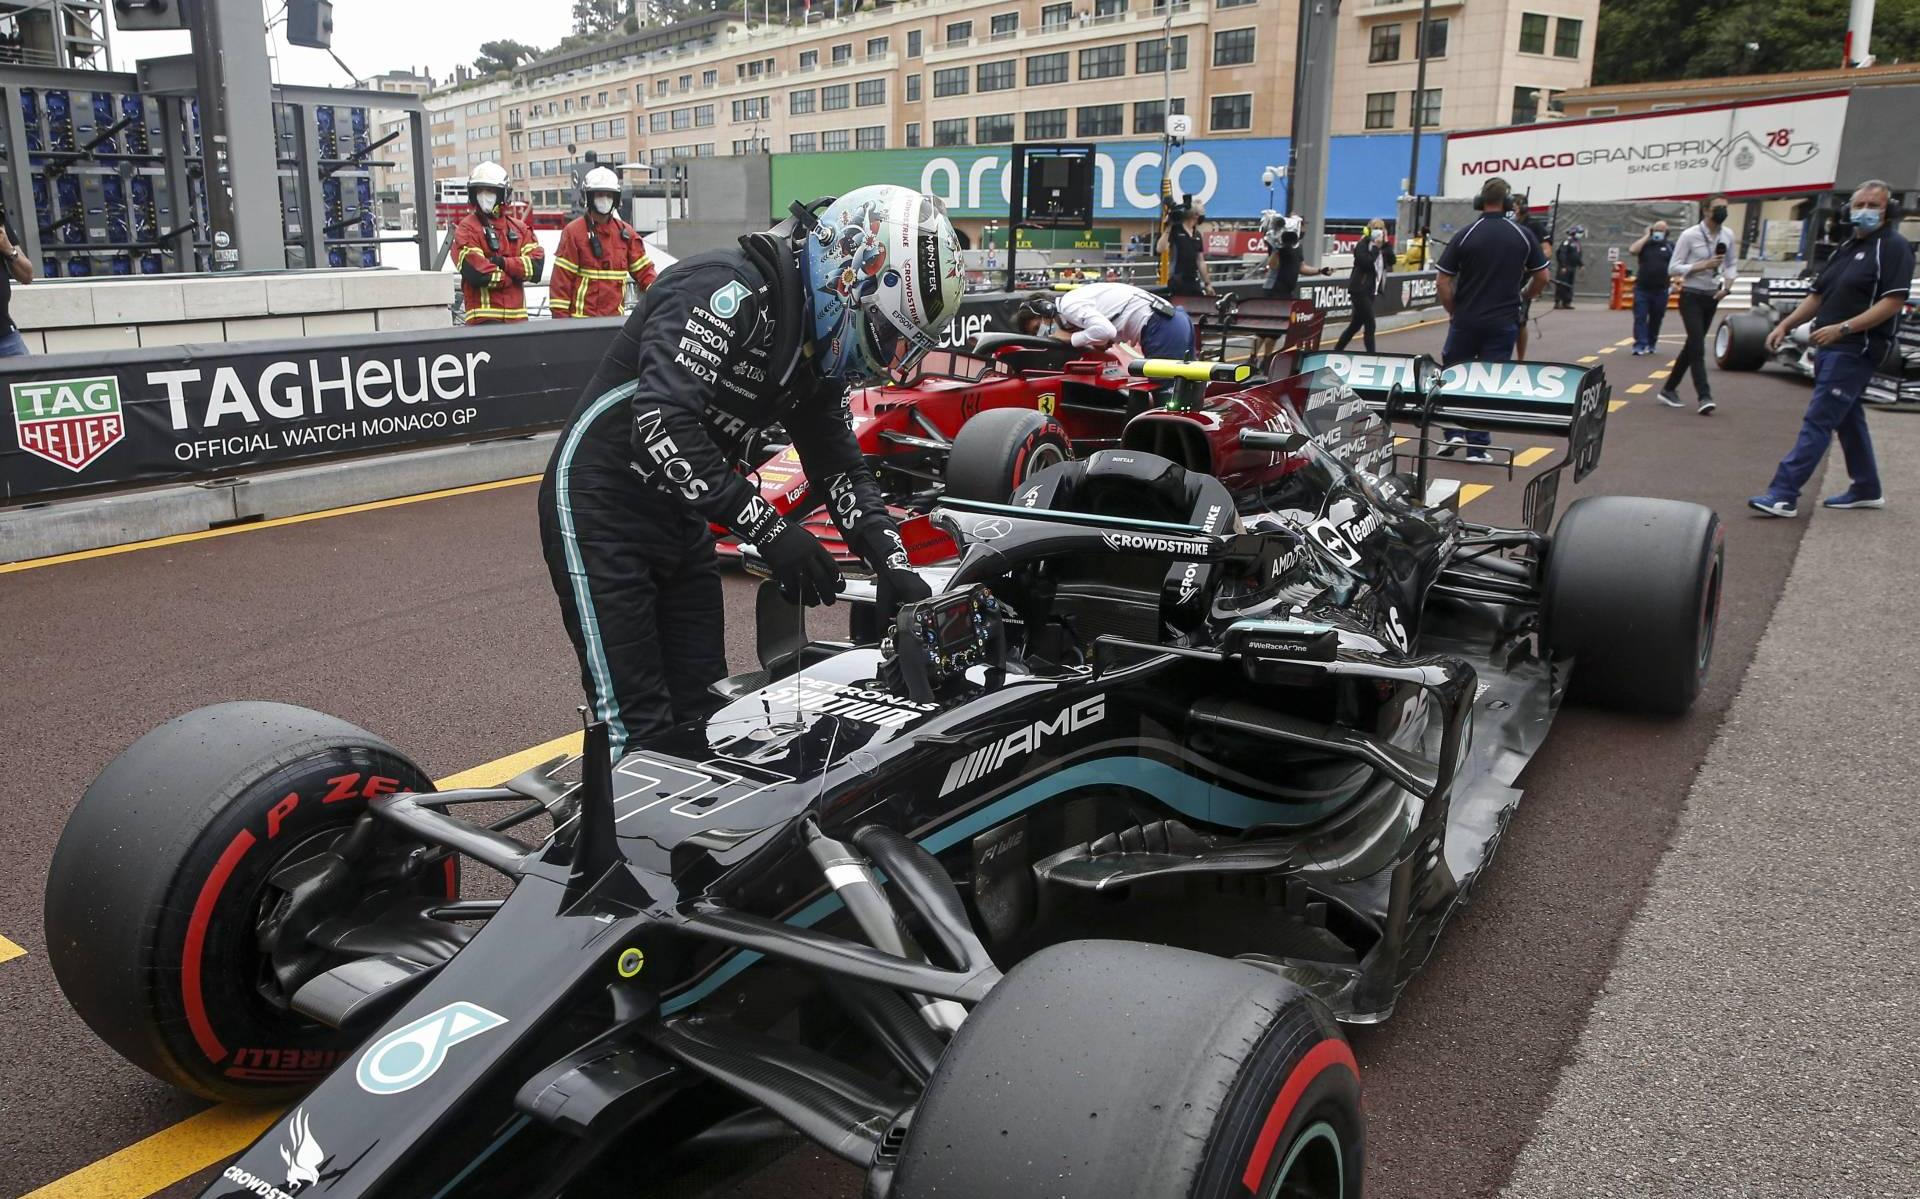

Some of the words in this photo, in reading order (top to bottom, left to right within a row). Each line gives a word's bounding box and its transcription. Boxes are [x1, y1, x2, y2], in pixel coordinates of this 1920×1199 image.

[920, 151, 1218, 210] arco
[1627, 161, 1670, 175] SINCE
[1673, 157, 1709, 171] 1929
[902, 262, 921, 326] CROWDSTRIKE
[1768, 279, 1812, 289] HON
[685, 318, 729, 355] EPSON
[692, 306, 736, 338] PETRONAS
[891, 310, 914, 331] EPSON
[674, 352, 707, 377] AMD
[20, 383, 112, 416] TAG
[23, 418, 118, 465] HEUER
[174, 432, 278, 461] OFFICIAL
[282, 421, 356, 446] WATCH
[362, 410, 447, 437] MONACO
[452, 407, 477, 425] GP
[636, 407, 709, 500] INEOS
[1110, 533, 1209, 556] CROWDSTRIKE
[795, 677, 941, 711] PETRONAS
[267, 791, 299, 840] P
[321, 772, 412, 804] ZE
